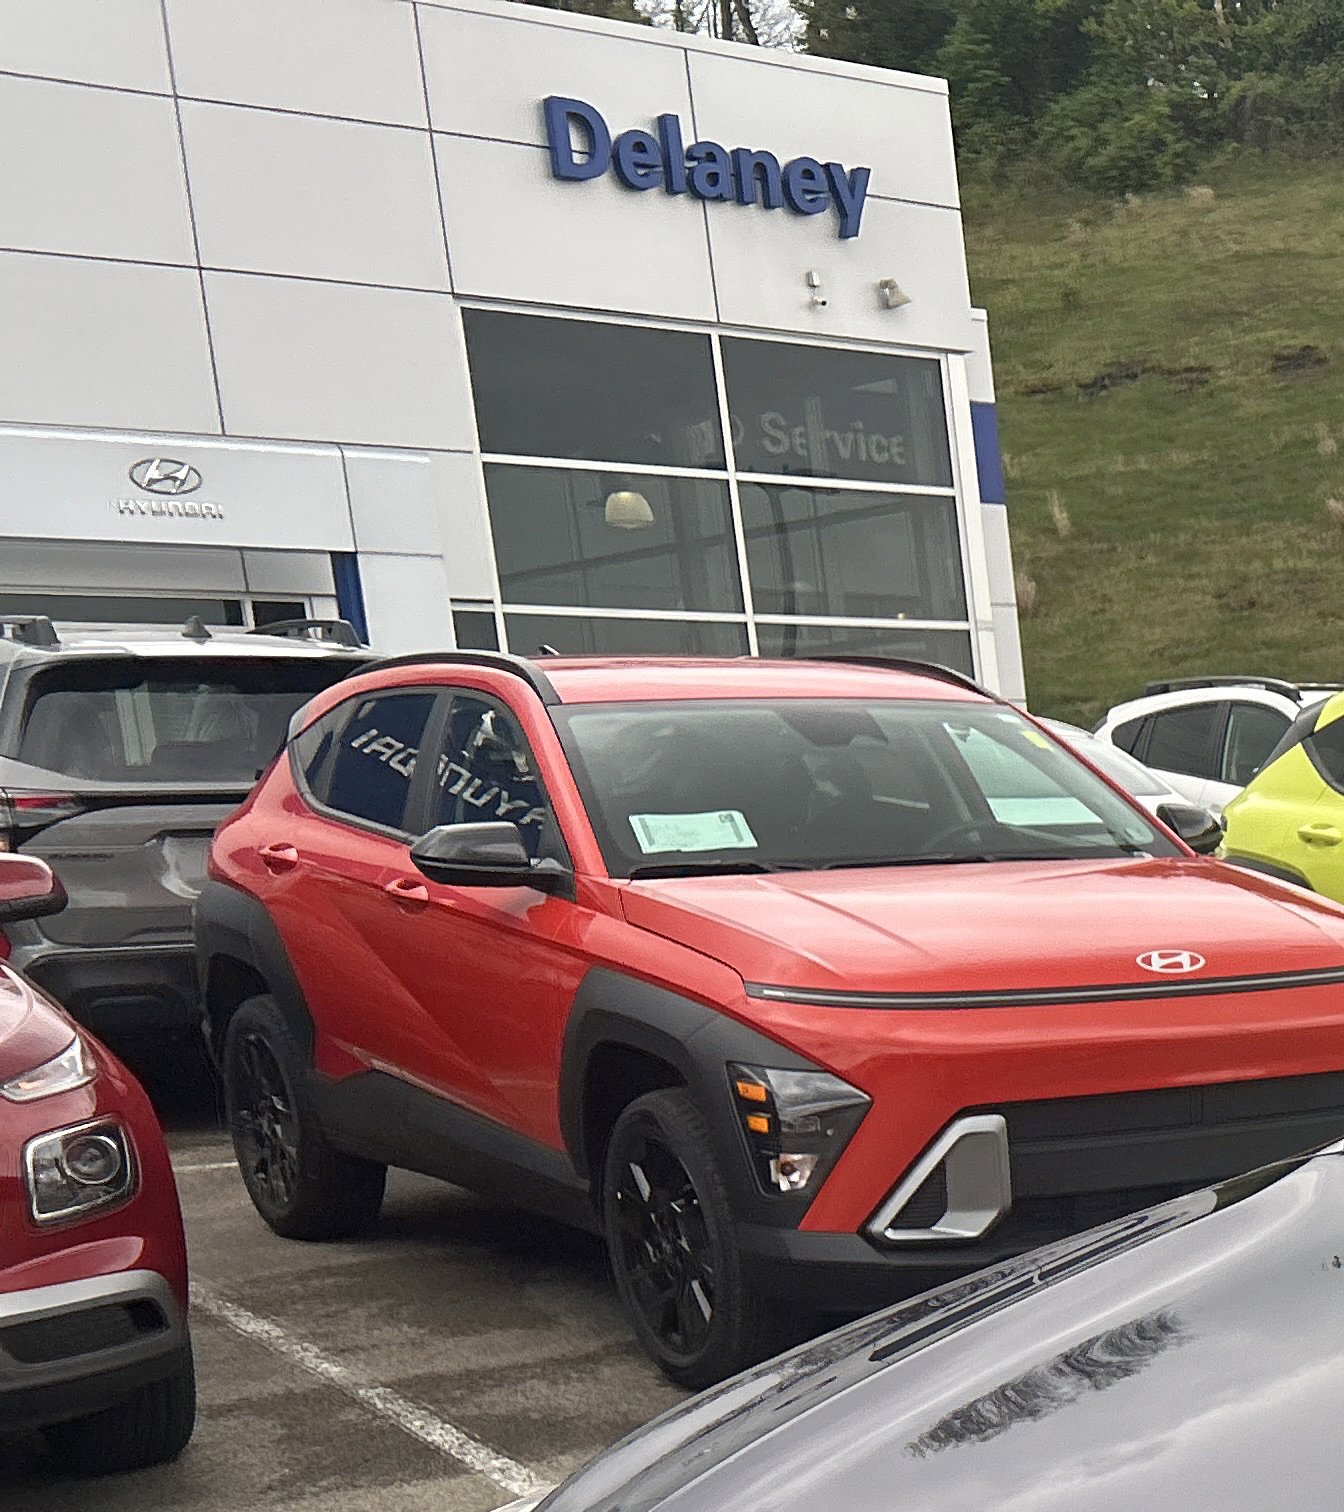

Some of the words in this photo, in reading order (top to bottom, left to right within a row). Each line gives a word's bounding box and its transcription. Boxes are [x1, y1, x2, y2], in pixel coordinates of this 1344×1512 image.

[543, 94, 872, 239] Delaney
[758, 411, 907, 466] Service
[118, 499, 225, 520] HYUNDAI
